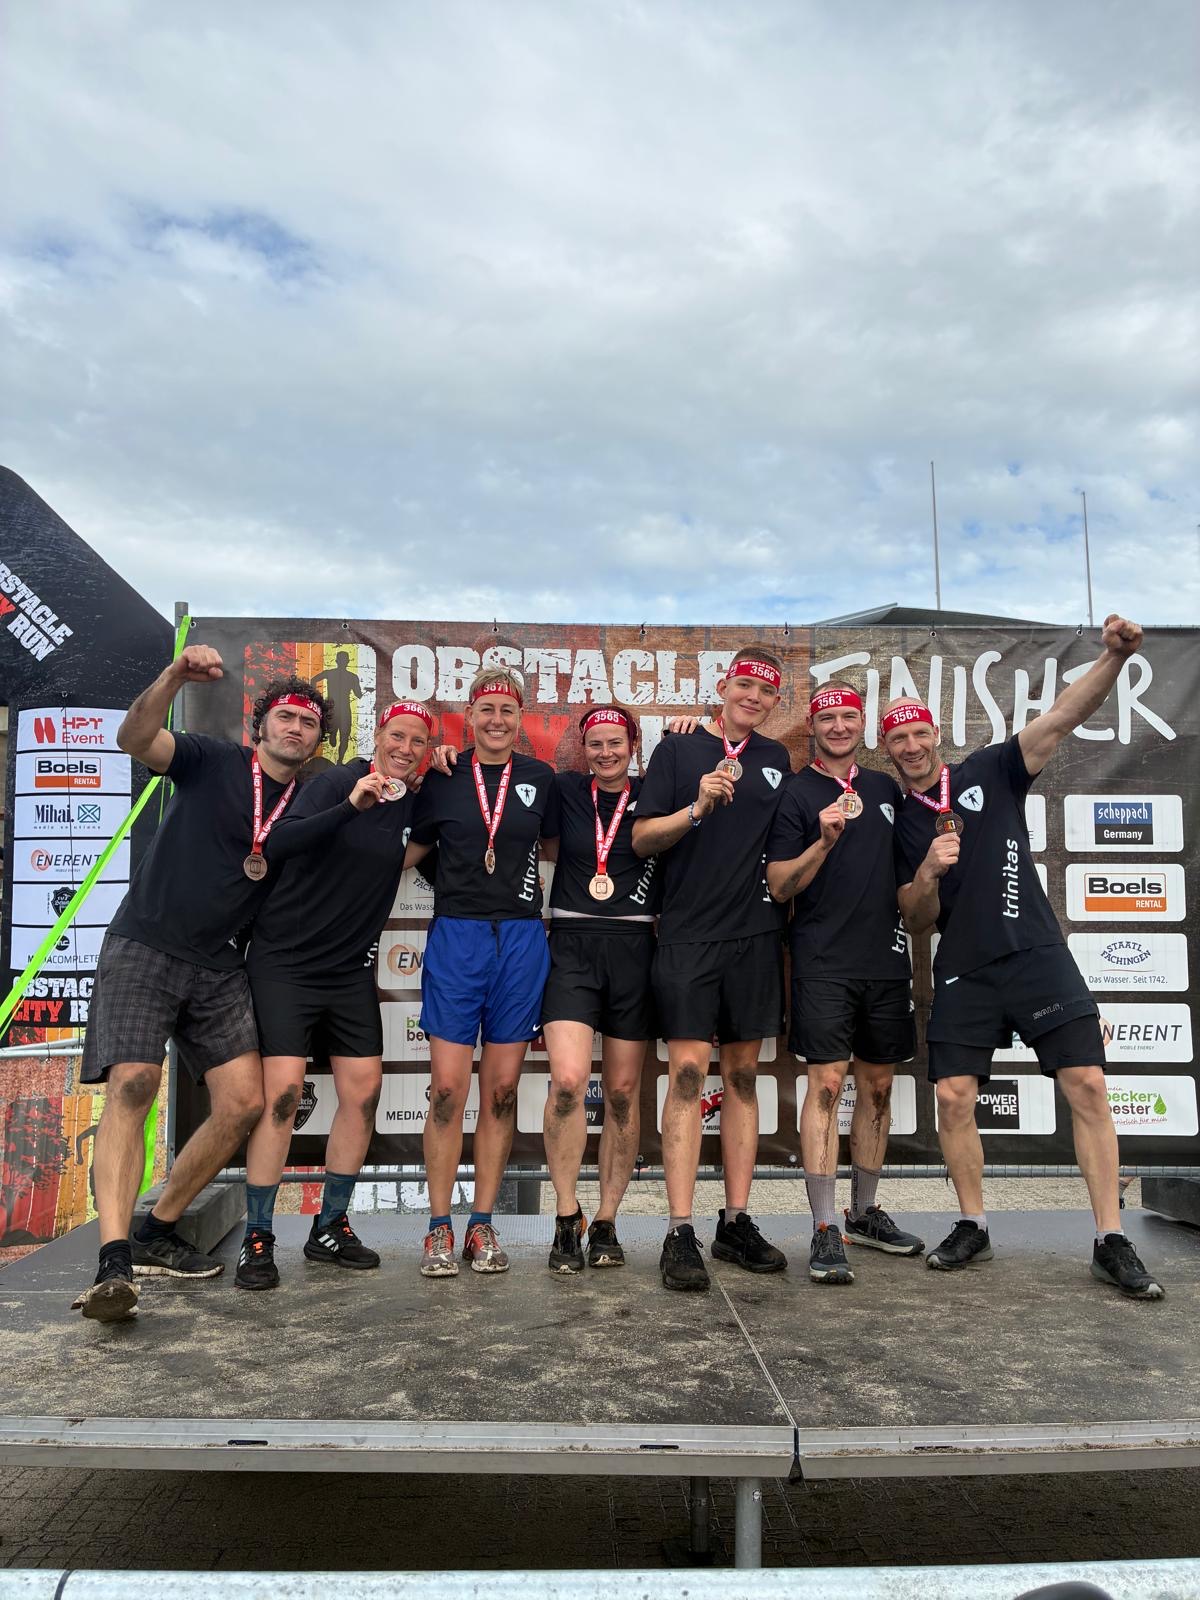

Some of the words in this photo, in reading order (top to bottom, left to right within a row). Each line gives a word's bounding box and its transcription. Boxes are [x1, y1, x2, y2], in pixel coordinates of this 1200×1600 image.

[0, 562, 74, 646] BSTACLE
[6, 612, 56, 661] RUN
[750, 665, 775, 682] 3566
[817, 695, 843, 709] 3563
[62, 717, 103, 729] HPT
[594, 712, 619, 723] 3565
[892, 709, 920, 724] 3564
[62, 732, 105, 744] Event
[37, 760, 98, 774] Boels
[1098, 802, 1149, 824] scheppach
[1103, 830, 1143, 840] Germany
[36, 854, 102, 867] ENERENT
[1002, 838, 1019, 918] trinitas
[1088, 877, 1162, 894] Boels
[1135, 900, 1162, 908] RENTAL
[27, 954, 100, 964] MACOMPLETE
[1101, 950, 1151, 965] FACHINGEN
[1103, 1024, 1182, 1041] NERENT
[992, 1105, 1018, 1115] ADE
[1109, 1103, 1151, 1115] ester
